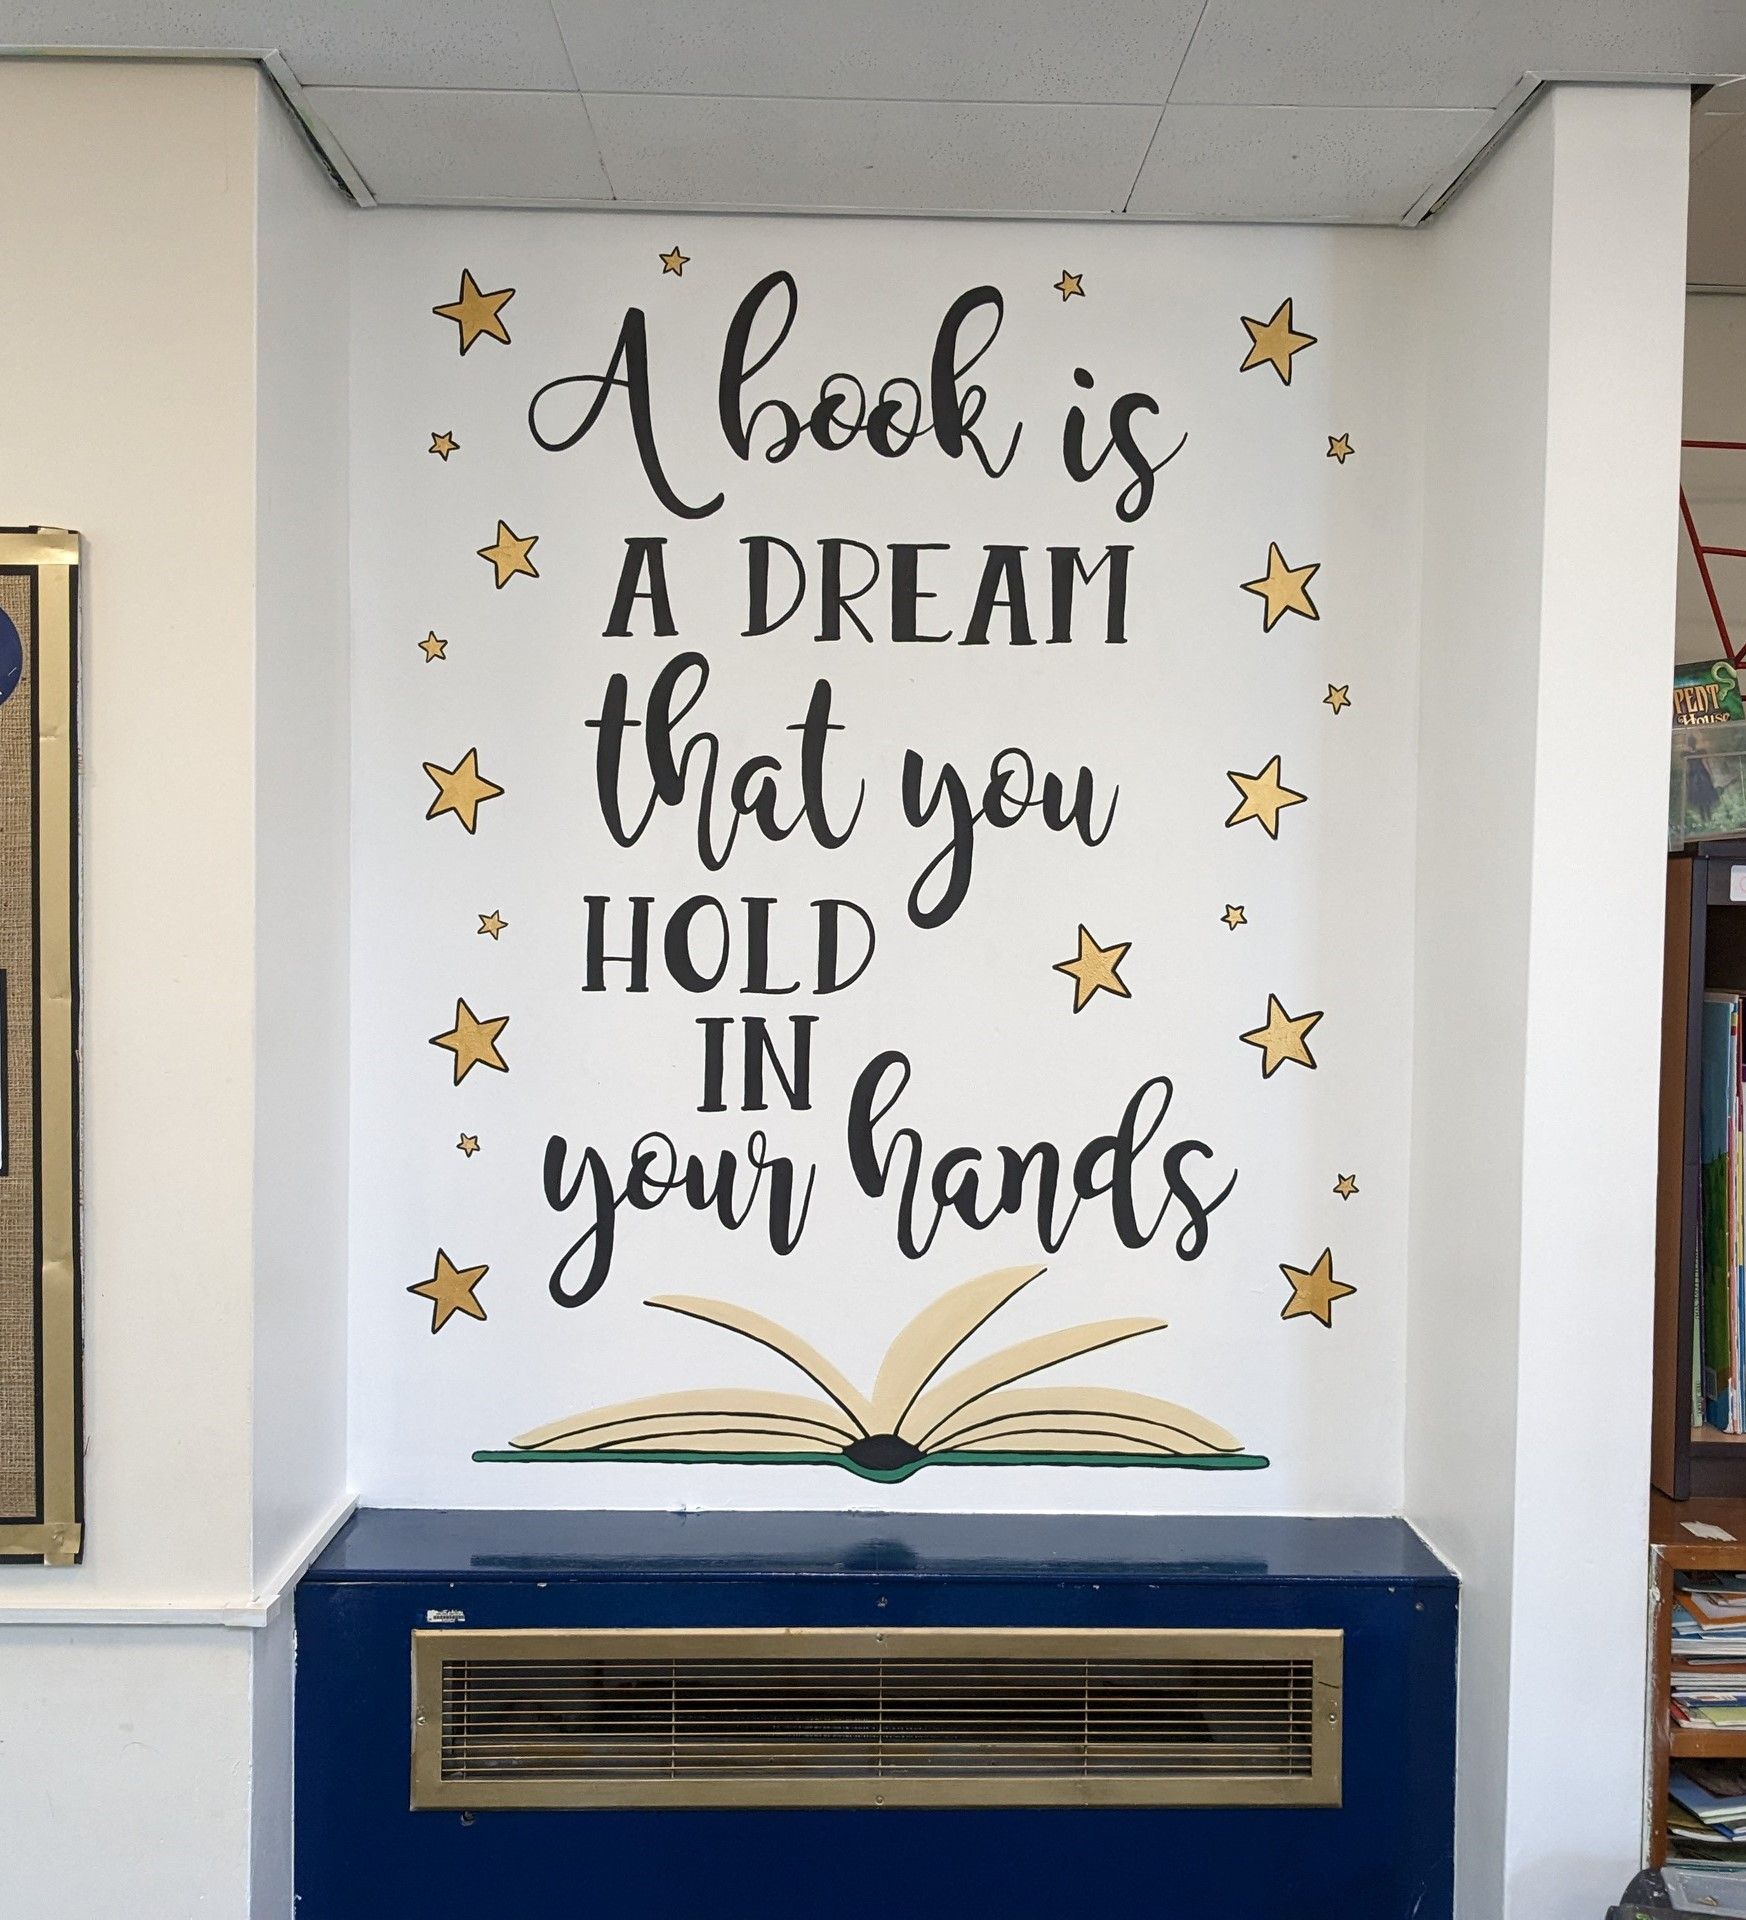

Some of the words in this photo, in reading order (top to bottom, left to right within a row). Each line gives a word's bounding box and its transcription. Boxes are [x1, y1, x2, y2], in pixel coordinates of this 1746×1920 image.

[528, 307, 725, 520] A
[718, 270, 1023, 479] book
[1062, 367, 1188, 523] is
[601, 536, 679, 638] A
[739, 535, 1135, 646] DREAM
[584, 651, 865, 872] that
[902, 747, 1119, 930] you
[581, 895, 876, 995] HOLD
[695, 1015, 820, 1113] IN
[543, 1130, 816, 1309] your
[847, 1050, 1238, 1262] hands
